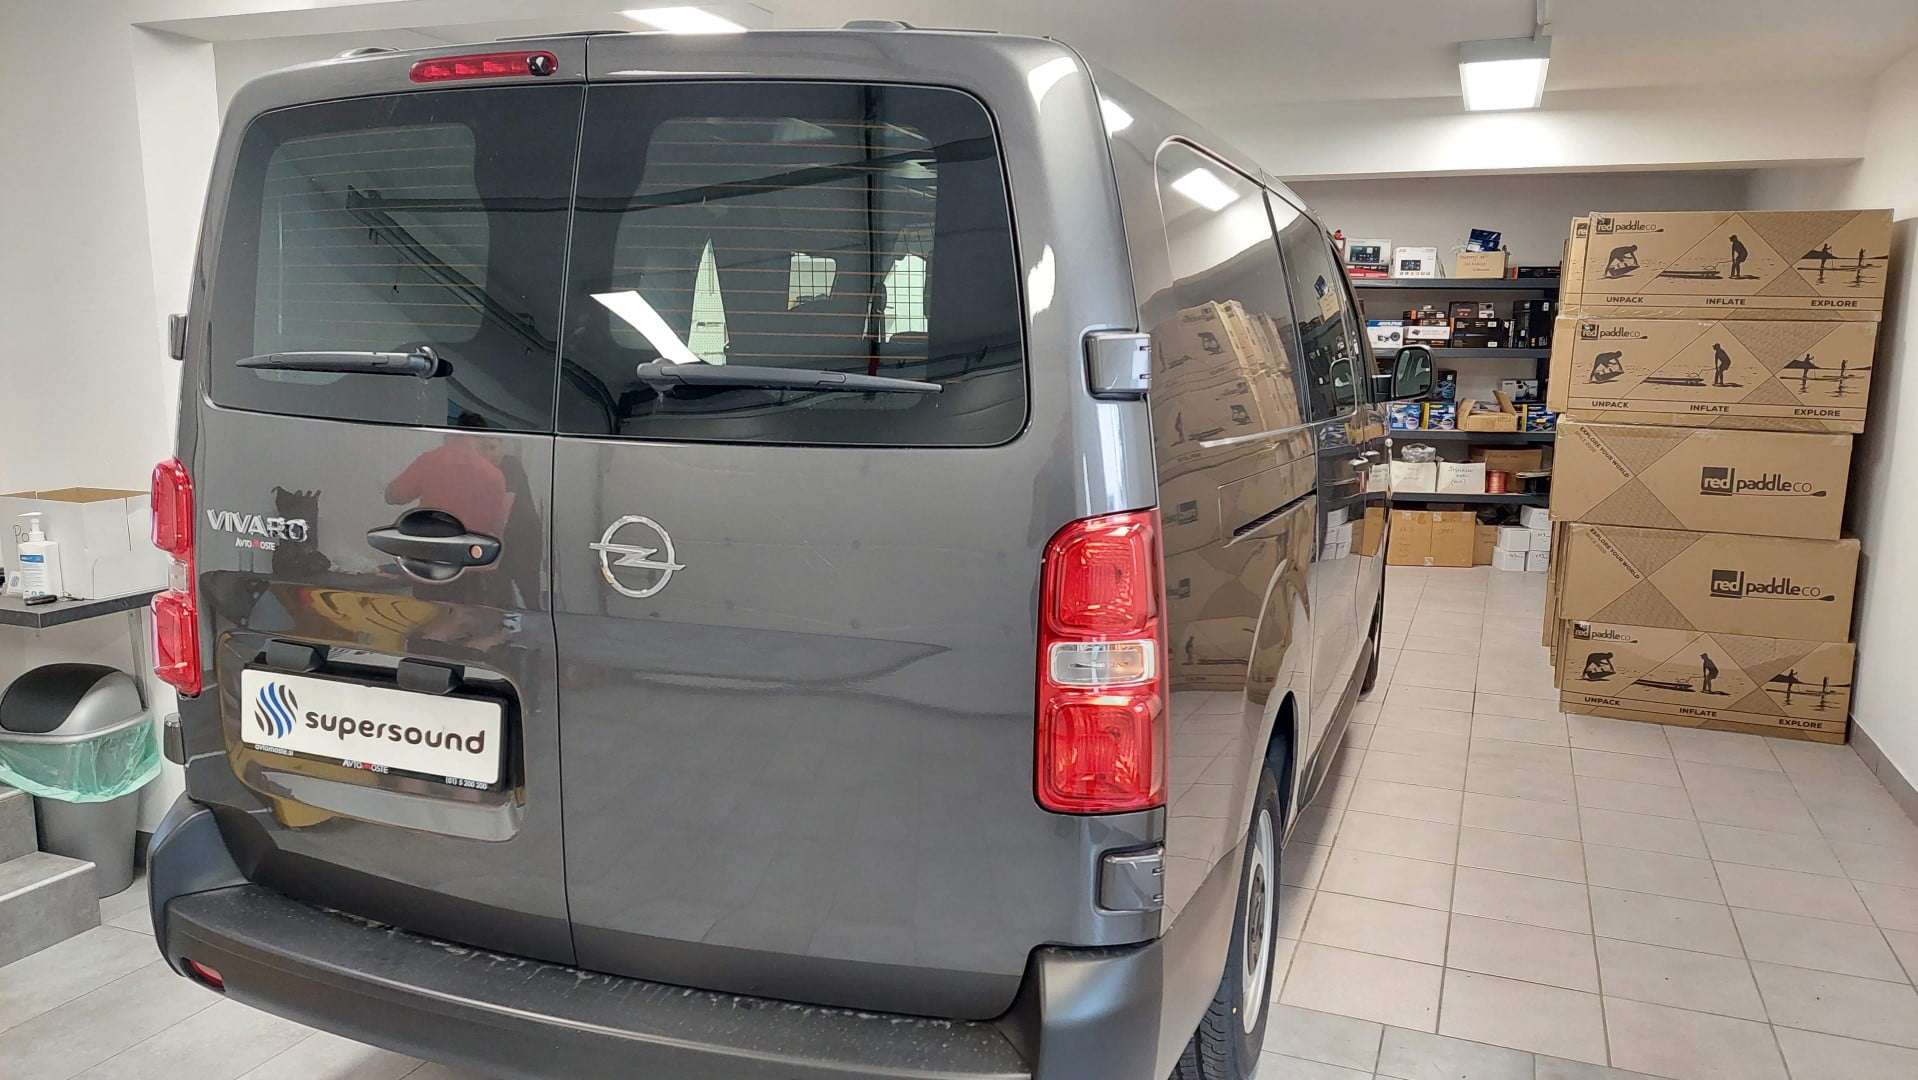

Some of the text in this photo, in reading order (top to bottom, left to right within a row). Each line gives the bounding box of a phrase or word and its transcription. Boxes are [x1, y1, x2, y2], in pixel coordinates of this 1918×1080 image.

[1606, 296, 1644, 304] UNPACK
[1705, 298, 1746, 306] INFLATE
[1810, 299, 1858, 308] EXPLORE
[1591, 400, 1629, 409] UNPACK
[1689, 404, 1730, 413] INFLATE
[1793, 408, 1841, 417] EXPLORE
[1580, 426, 1601, 449] EXPLORE
[1599, 447, 1614, 462] YOUR
[1612, 460, 1630, 478] WORLD
[1702, 467, 1735, 492] red
[206, 508, 308, 542] VIVARO
[1590, 528, 1611, 550] EXPLORE
[1609, 548, 1624, 562] YOUR
[1622, 561, 1640, 579] WORLD
[1711, 570, 1744, 596] red
[1584, 696, 1621, 706] UNPACK
[1679, 707, 1718, 718] INFLATE
[1778, 718, 1824, 729] EXPLORE
[304, 711, 486, 755] supersound
